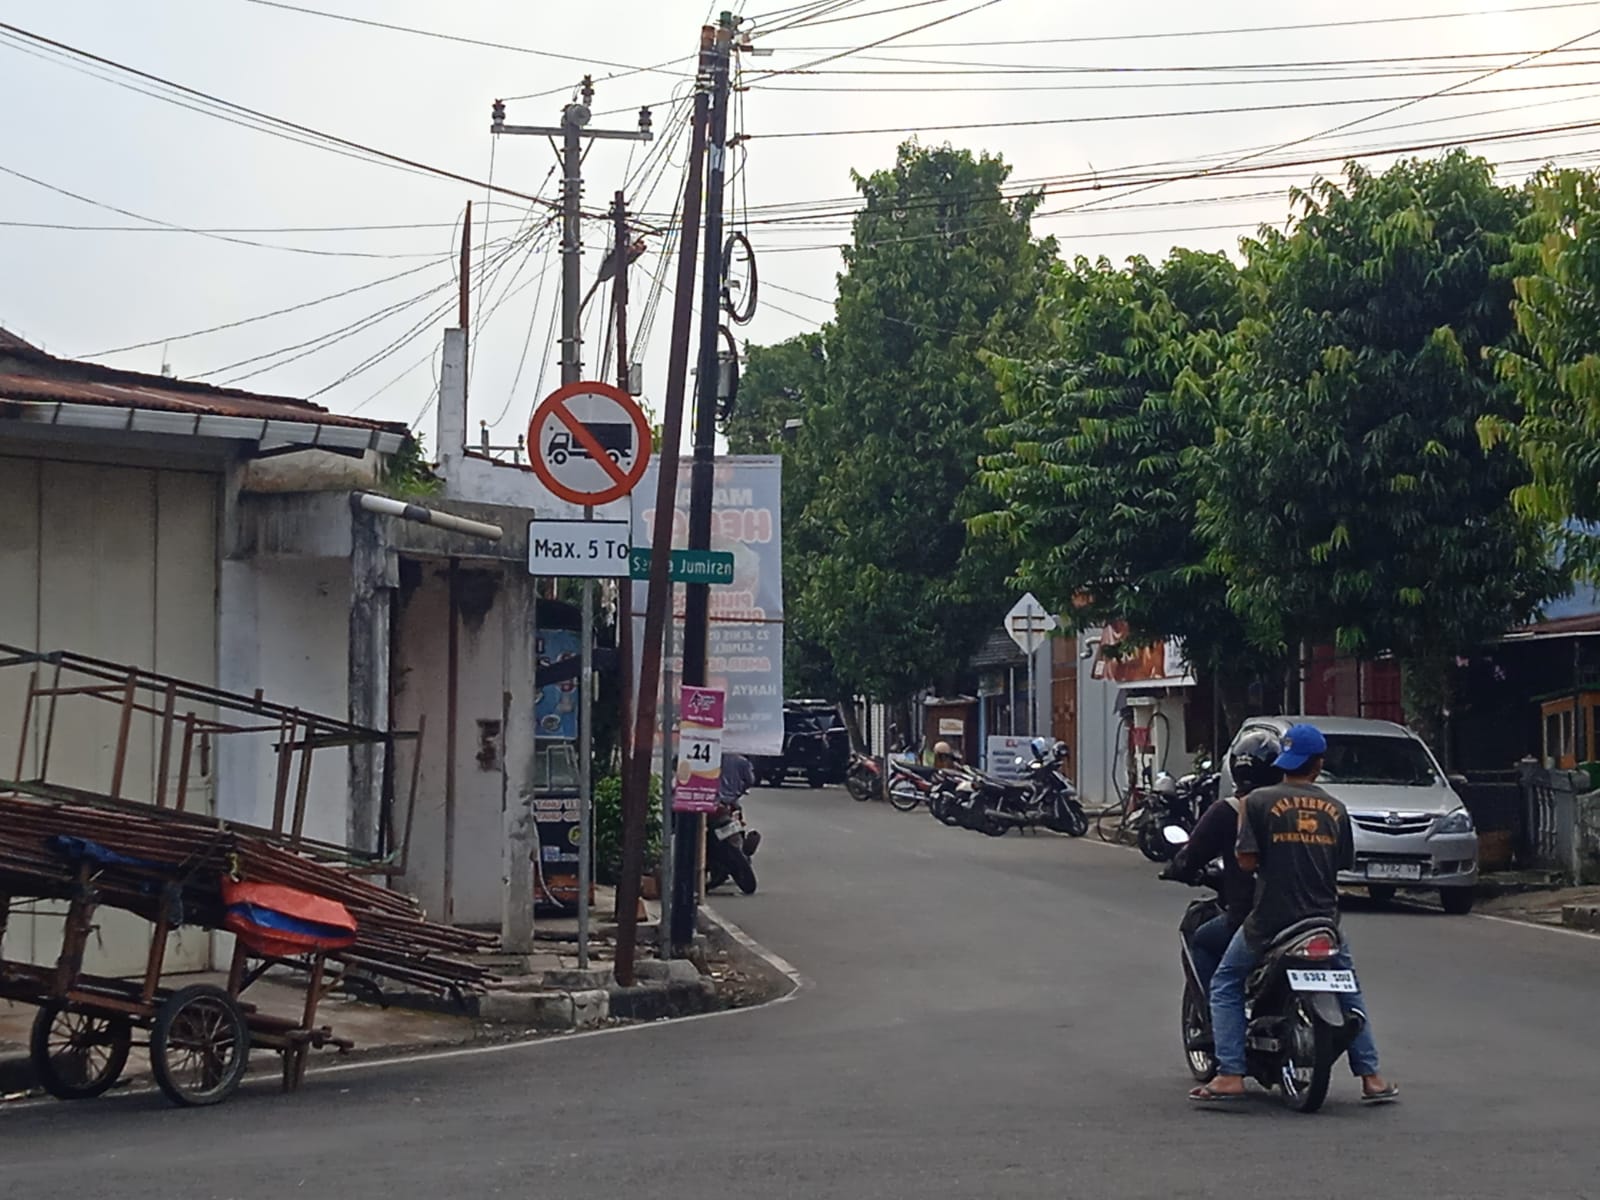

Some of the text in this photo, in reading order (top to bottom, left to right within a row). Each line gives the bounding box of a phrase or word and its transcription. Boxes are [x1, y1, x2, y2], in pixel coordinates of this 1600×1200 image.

[534, 539, 630, 559] Max. 5 To
[679, 558, 732, 576] Jumiran
